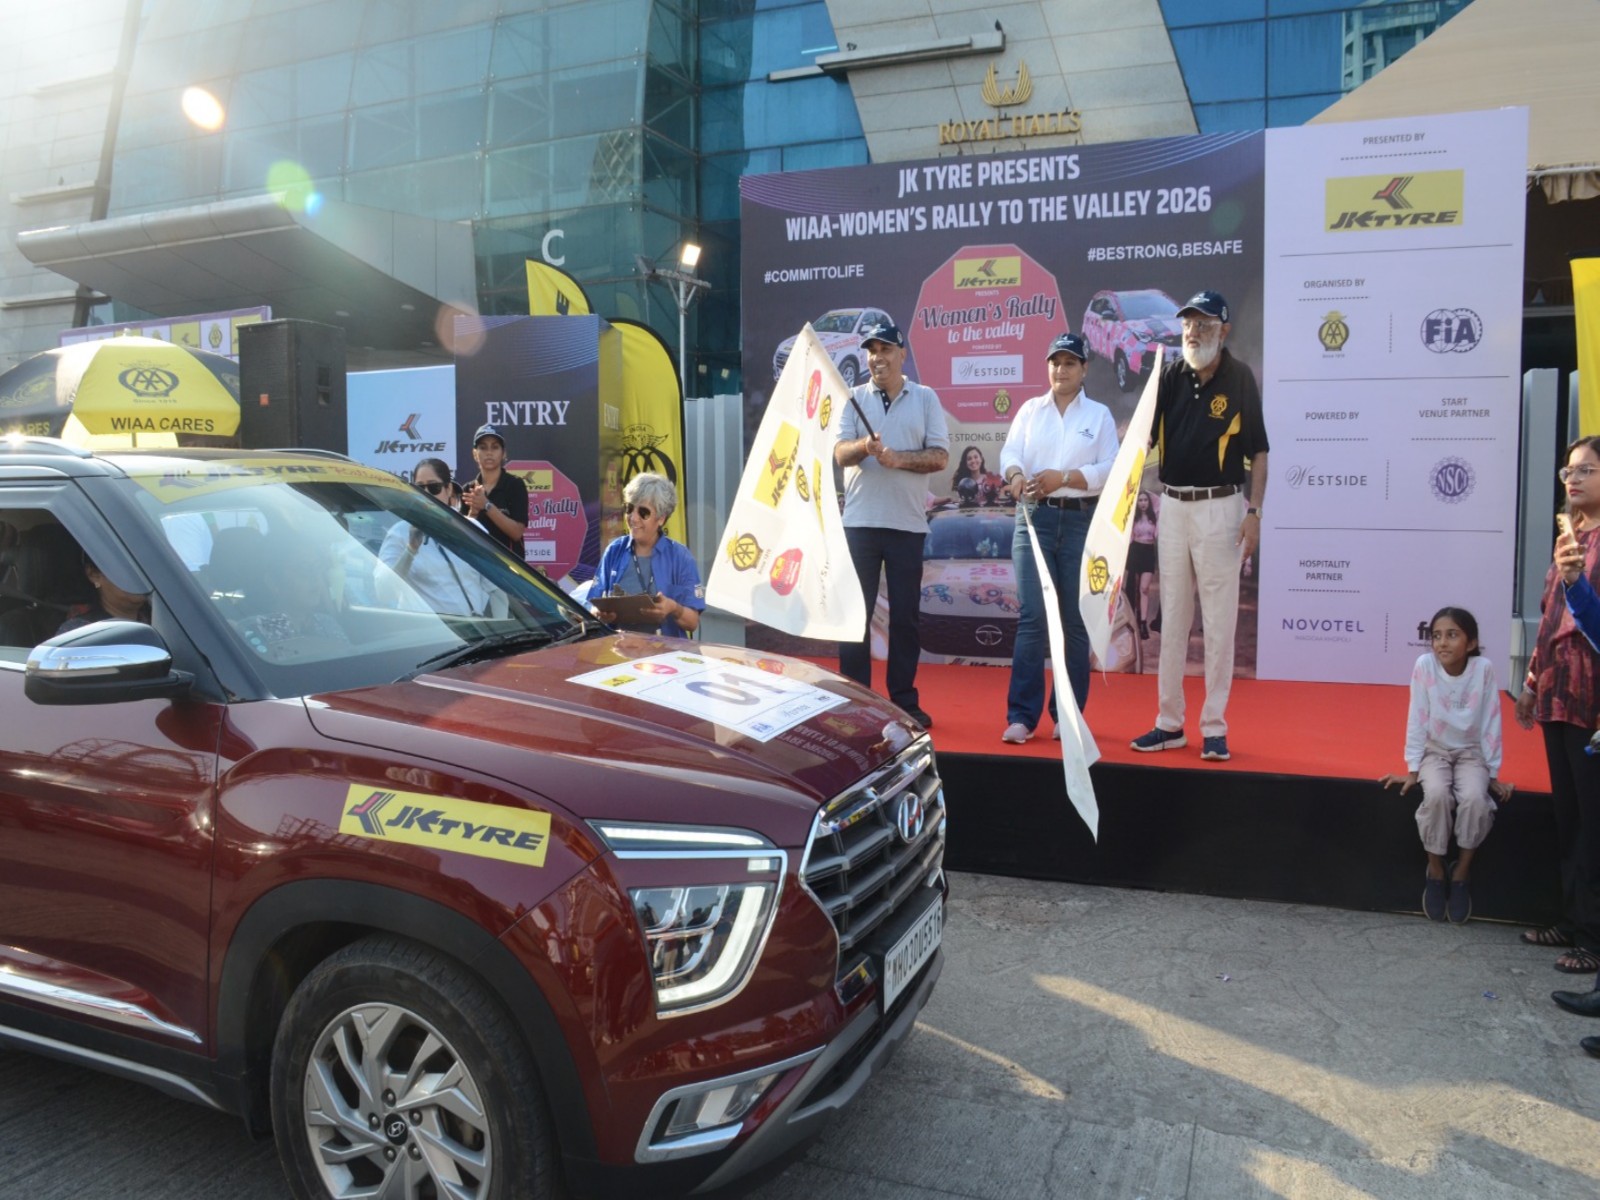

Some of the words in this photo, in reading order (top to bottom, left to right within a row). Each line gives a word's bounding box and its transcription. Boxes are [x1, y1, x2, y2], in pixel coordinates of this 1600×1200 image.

[939, 119, 1006, 144] ROYAL
[1011, 111, 1082, 137] HALLS
[1363, 134, 1412, 145] PRESENTED
[1414, 133, 1425, 142] BY
[898, 169, 919, 198] JK
[922, 163, 974, 193] TYRE
[977, 154, 1080, 187] PRESENTS
[786, 205, 928, 241] WIAA-WOMEN'S
[932, 200, 993, 232] RALLY
[998, 199, 1023, 225] TO
[1028, 195, 1067, 222] THE
[1073, 189, 1150, 220] VALLEY
[1156, 186, 1211, 213] 2026
[541, 229, 565, 266] C
[763, 264, 865, 283] #COMMITTOLIFE
[1303, 279, 1353, 289] ORGANISED
[1355, 278, 1365, 287] BY
[919, 301, 1002, 329] Women's
[1006, 293, 1057, 321] Rally
[948, 328, 960, 343] to
[963, 326, 983, 341] the
[985, 321, 1025, 341] valley
[958, 360, 1017, 378] WESTSIDE
[1441, 398, 1468, 406] START
[485, 401, 570, 426] ENTRY
[1305, 411, 1347, 420] POWERED
[1348, 411, 1360, 420] BY
[1419, 409, 1448, 418] VENUE
[1450, 409, 1490, 418] PARTNER
[111, 417, 156, 431] WIAA
[159, 417, 215, 432] CARES
[995, 432, 1006, 441] BE
[1285, 464, 1367, 490] WESTSIDE
[543, 497, 578, 518] Rally
[1299, 560, 1350, 569] HOSPITALITY
[1305, 572, 1343, 581] PARTNER
[1281, 618, 1365, 633] NOVOTEL
[385, 805, 545, 851] JKTYRE
